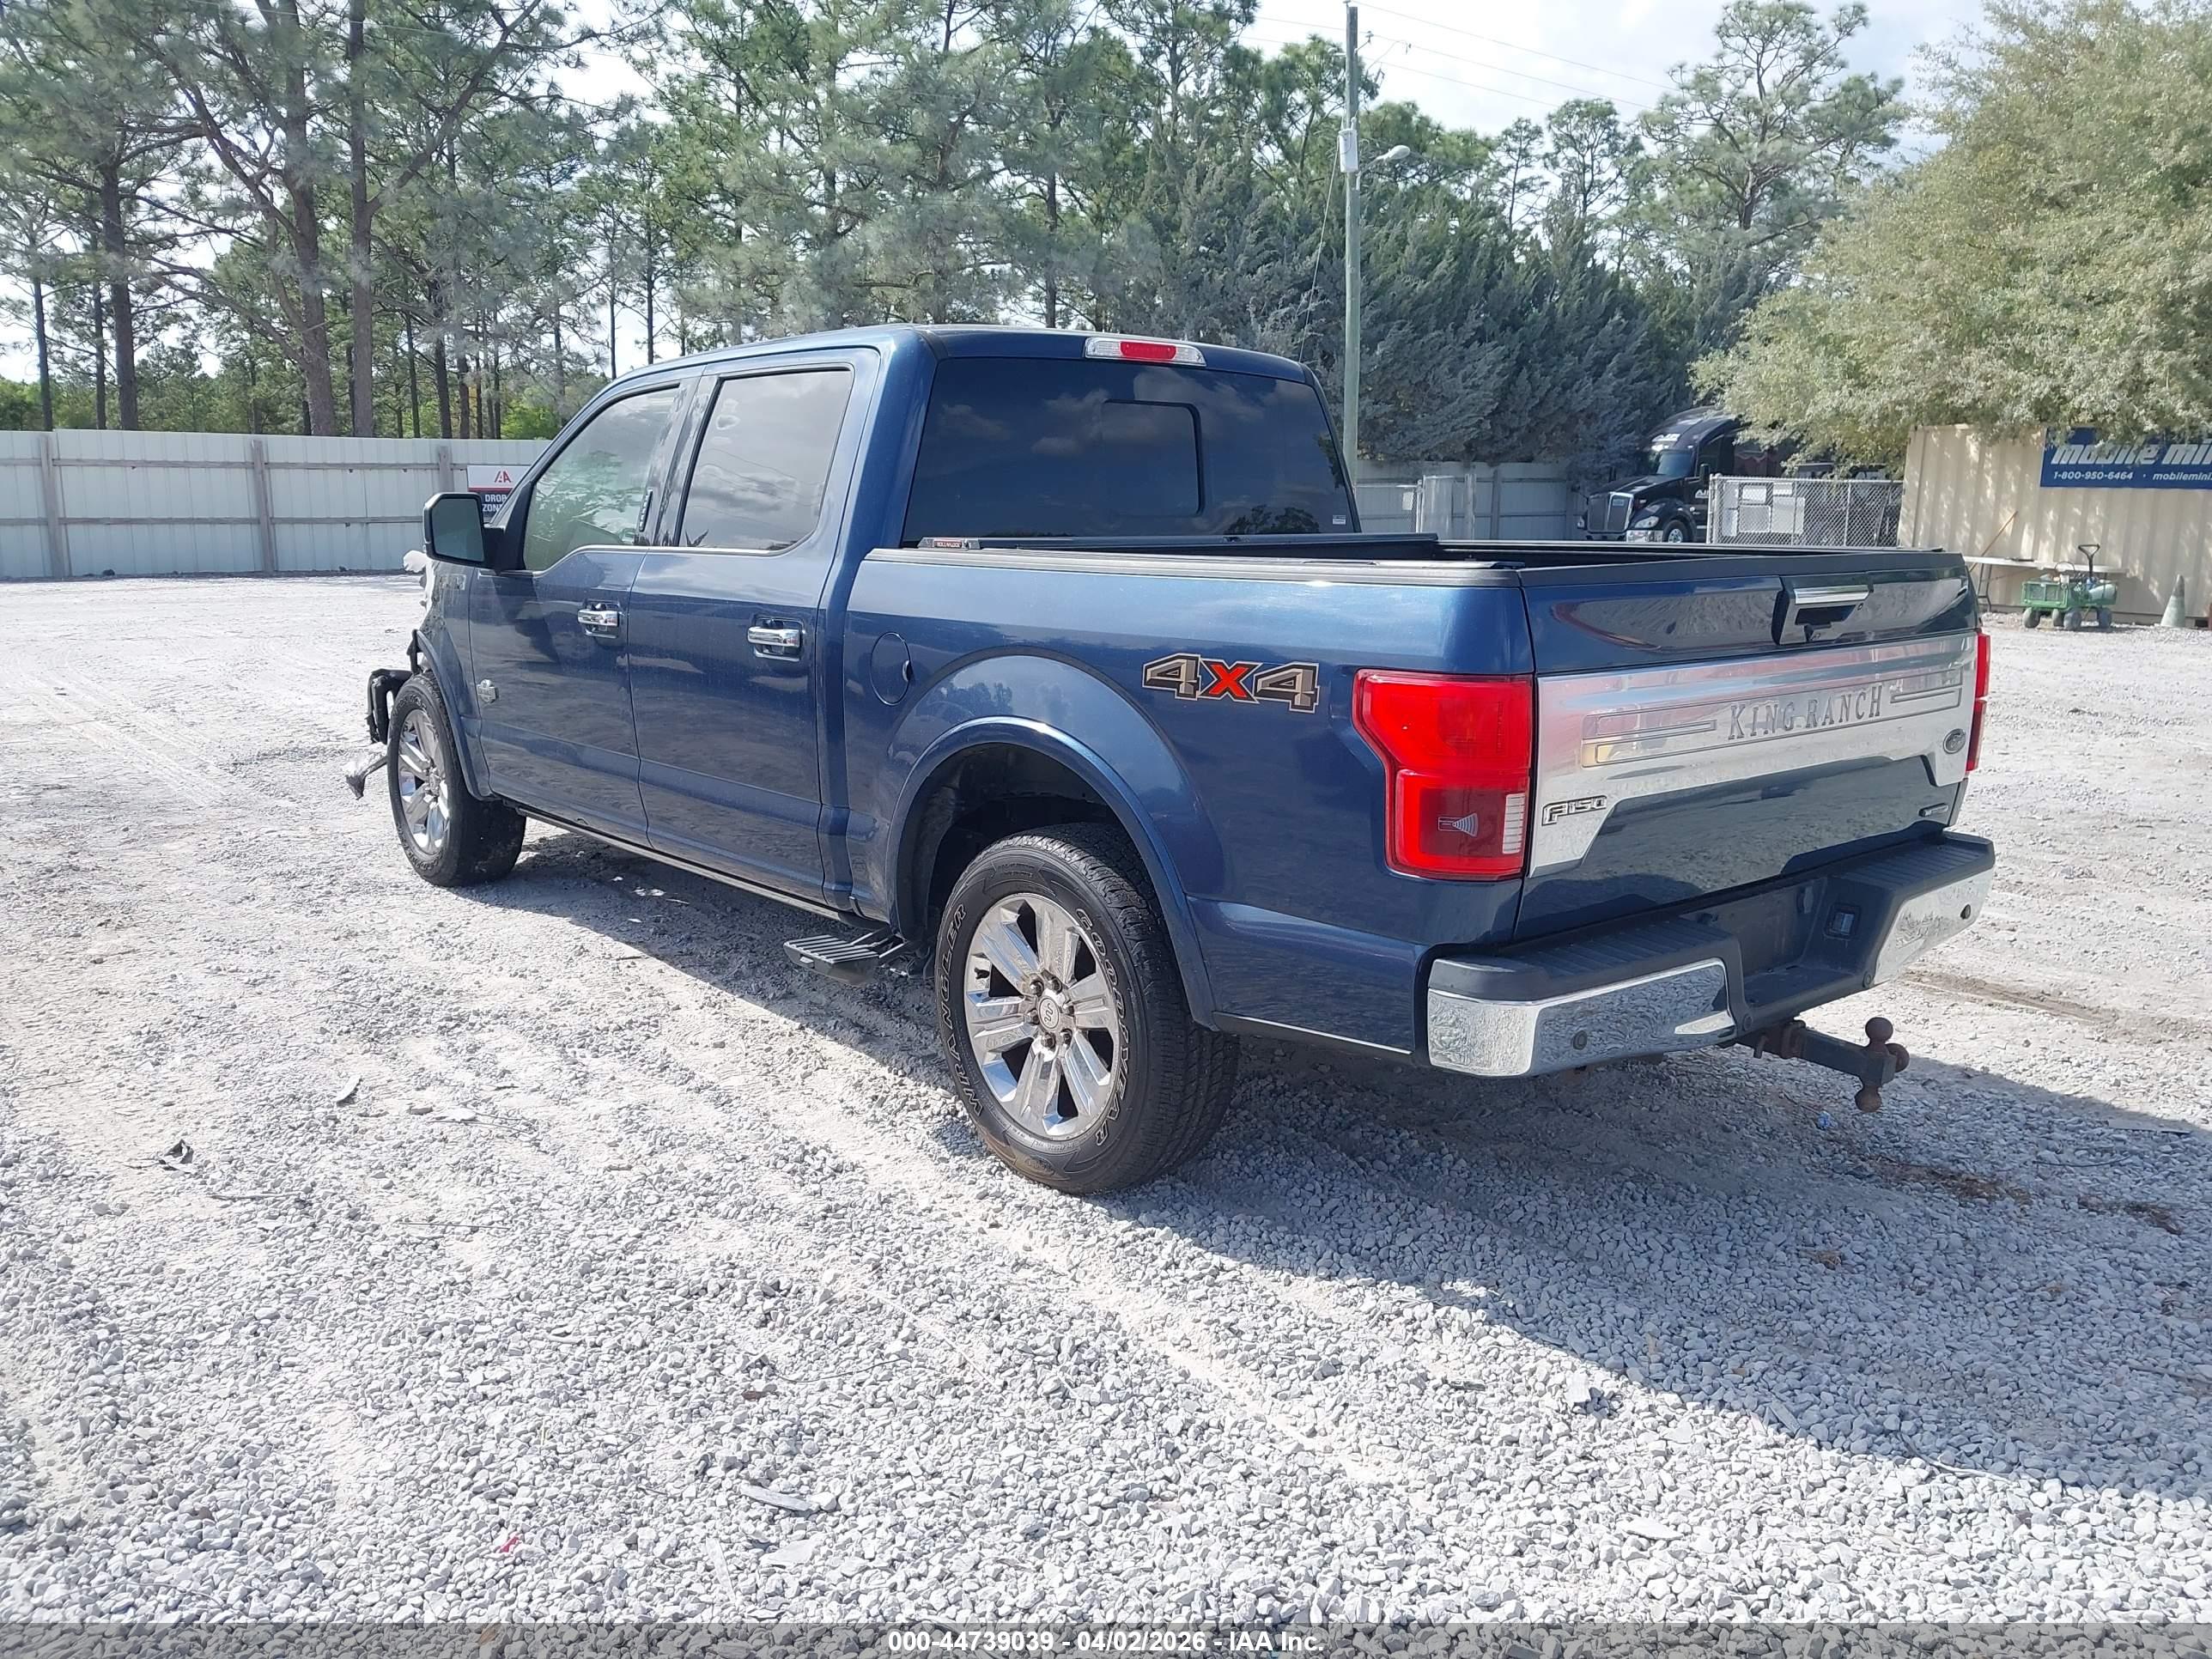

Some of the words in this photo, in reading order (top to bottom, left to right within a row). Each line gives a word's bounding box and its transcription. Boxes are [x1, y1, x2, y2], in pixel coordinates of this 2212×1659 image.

[2053, 471, 2134, 480] 1-800-950-6464
[1728, 701, 1796, 740] KING
[1805, 683, 1883, 729] RANCH
[937, 903, 984, 1116] WRANGLER
[1076, 908, 1130, 1147] GOODYEAR
